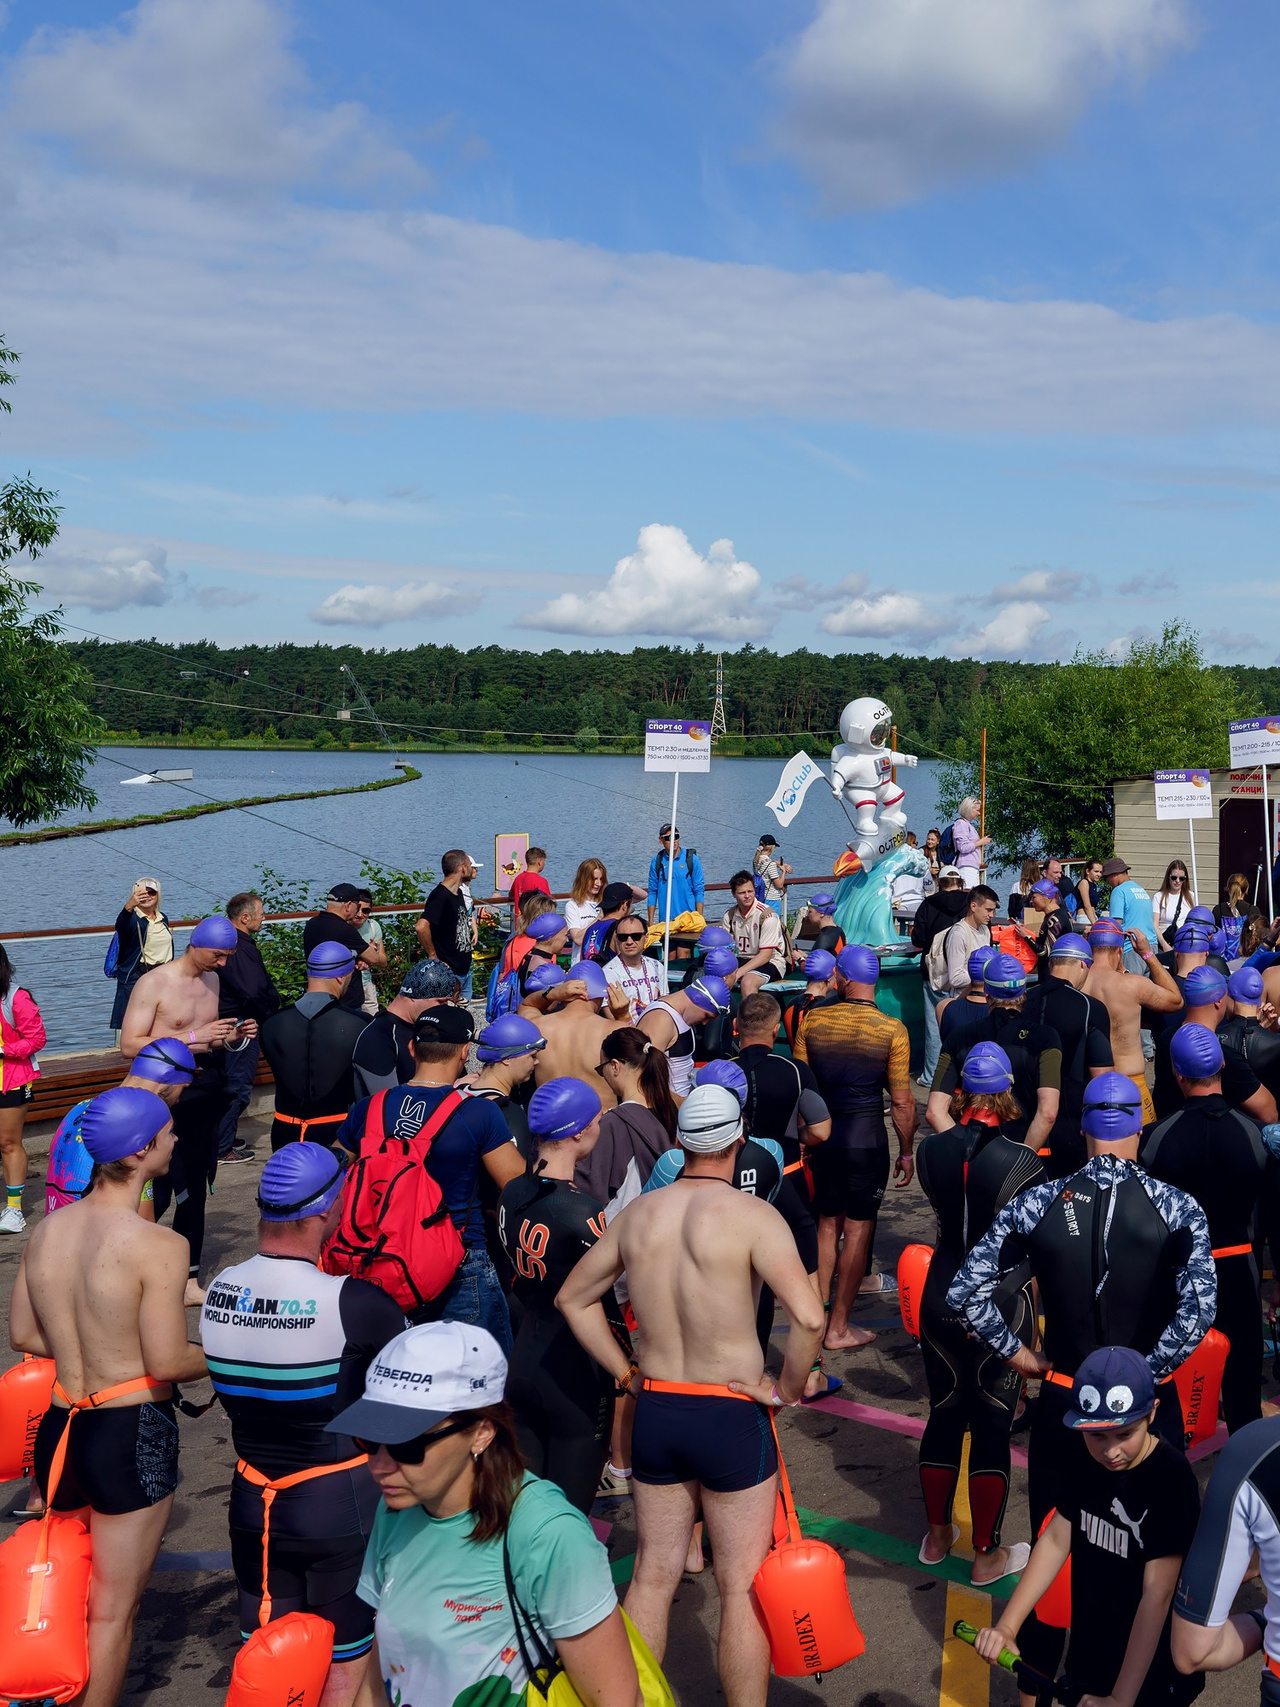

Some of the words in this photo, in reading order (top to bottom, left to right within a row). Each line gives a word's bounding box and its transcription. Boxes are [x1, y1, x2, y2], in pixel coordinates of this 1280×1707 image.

[1231, 723, 1250, 731] СПОРТ
[1231, 786, 1265, 794] СТАНЦИ
[280, 1299, 317, 1315] 70.3
[903, 1285, 915, 1329] BRADEX
[204, 1308, 229, 1324] WORLD
[232, 1314, 316, 1329] CHAMPIONSHIP
[1186, 1374, 1205, 1425] BRADEX
[22, 1412, 43, 1463] BRADEX
[454, 1613, 482, 1623] парк
[793, 1612, 822, 1668] BRADEX
